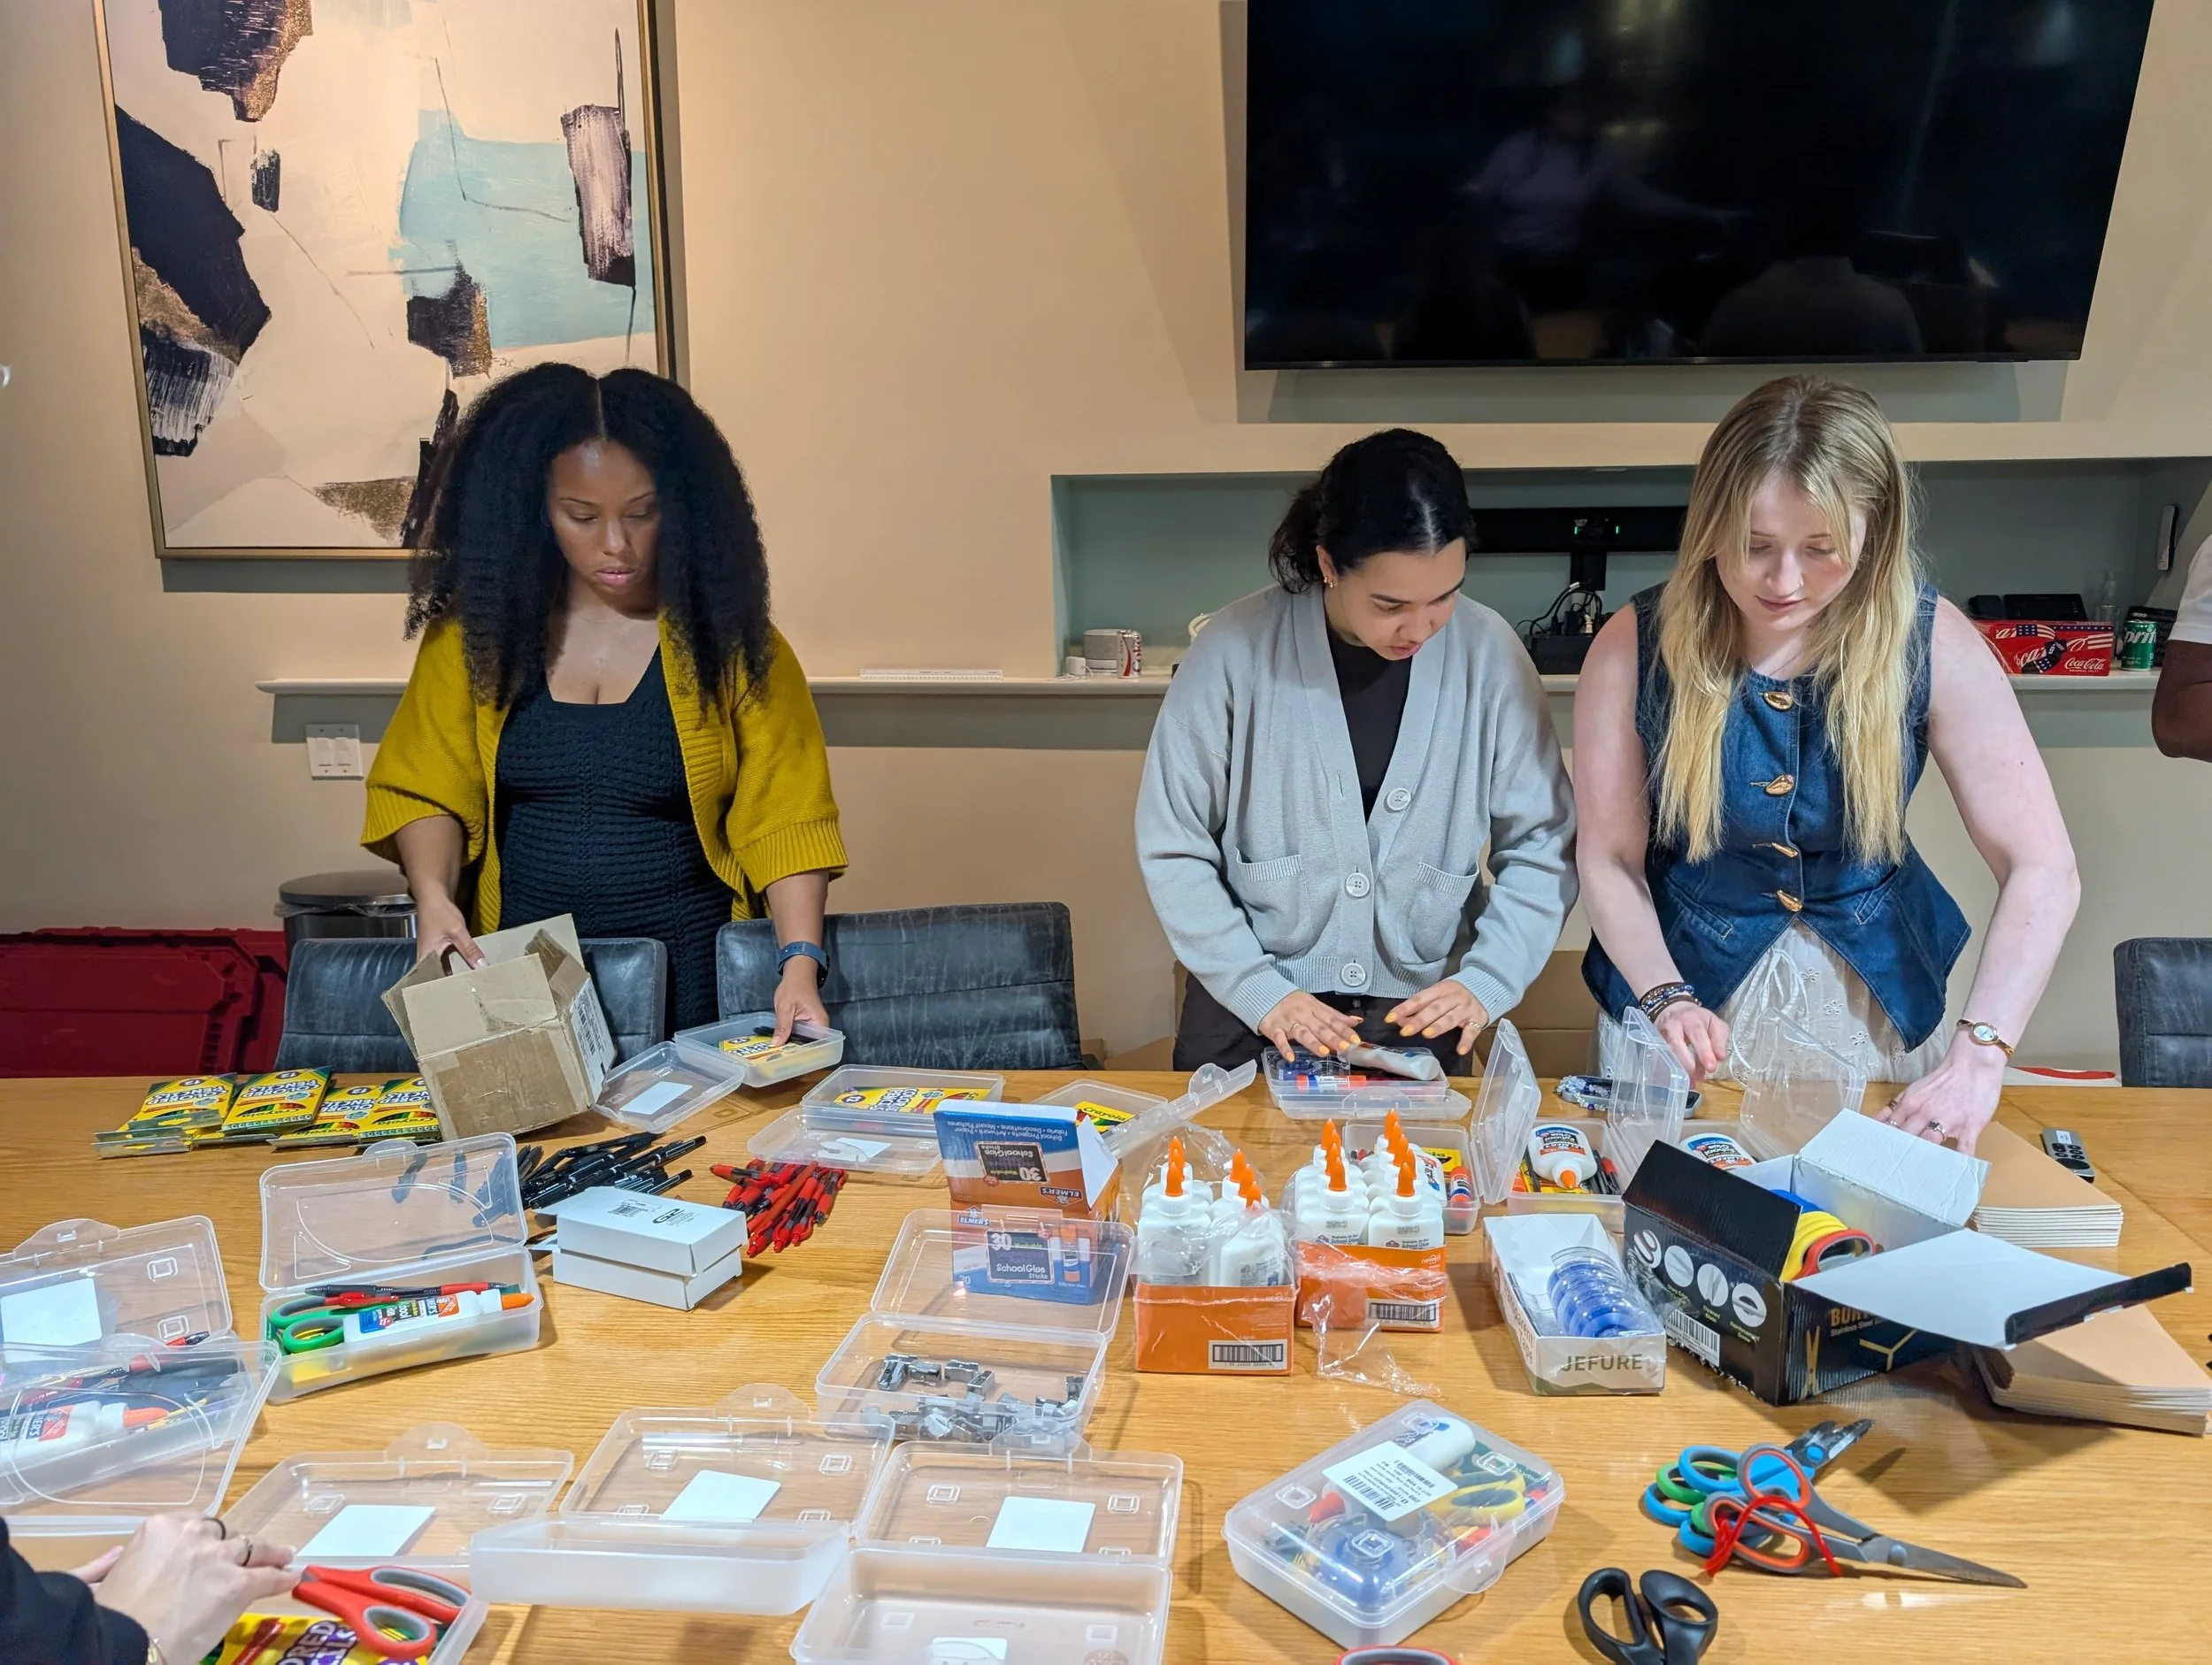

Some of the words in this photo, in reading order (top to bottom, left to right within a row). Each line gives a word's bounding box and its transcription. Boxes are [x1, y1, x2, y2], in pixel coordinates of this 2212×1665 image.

[2124, 625, 2156, 644] prit
[2065, 657, 2107, 670] Coca-Cola
[153, 1086, 225, 1099] PENCILS
[242, 1084, 320, 1098] COLORED
[250, 1079, 318, 1093] PENCILS
[146, 1089, 228, 1105] COLORED
[378, 1095, 431, 1104] LORED
[321, 1102, 373, 1112] OLORE
[1084, 1107, 1126, 1121] Crayola
[947, 1121, 975, 1130] Pictures
[1001, 1124, 1042, 1133] Decorations
[1019, 1166, 1042, 1181] 30
[1041, 1187, 1080, 1198] ELMER'S
[959, 1217, 989, 1226] ELMER'S
[990, 1232, 1012, 1251] 30
[996, 1262, 1025, 1272] School
[1025, 1264, 1046, 1273] Glue
[1830, 1325, 1857, 1337] Stainless
[1562, 1353, 1643, 1371] JEFURE
[279, 1621, 337, 1665] ORED
